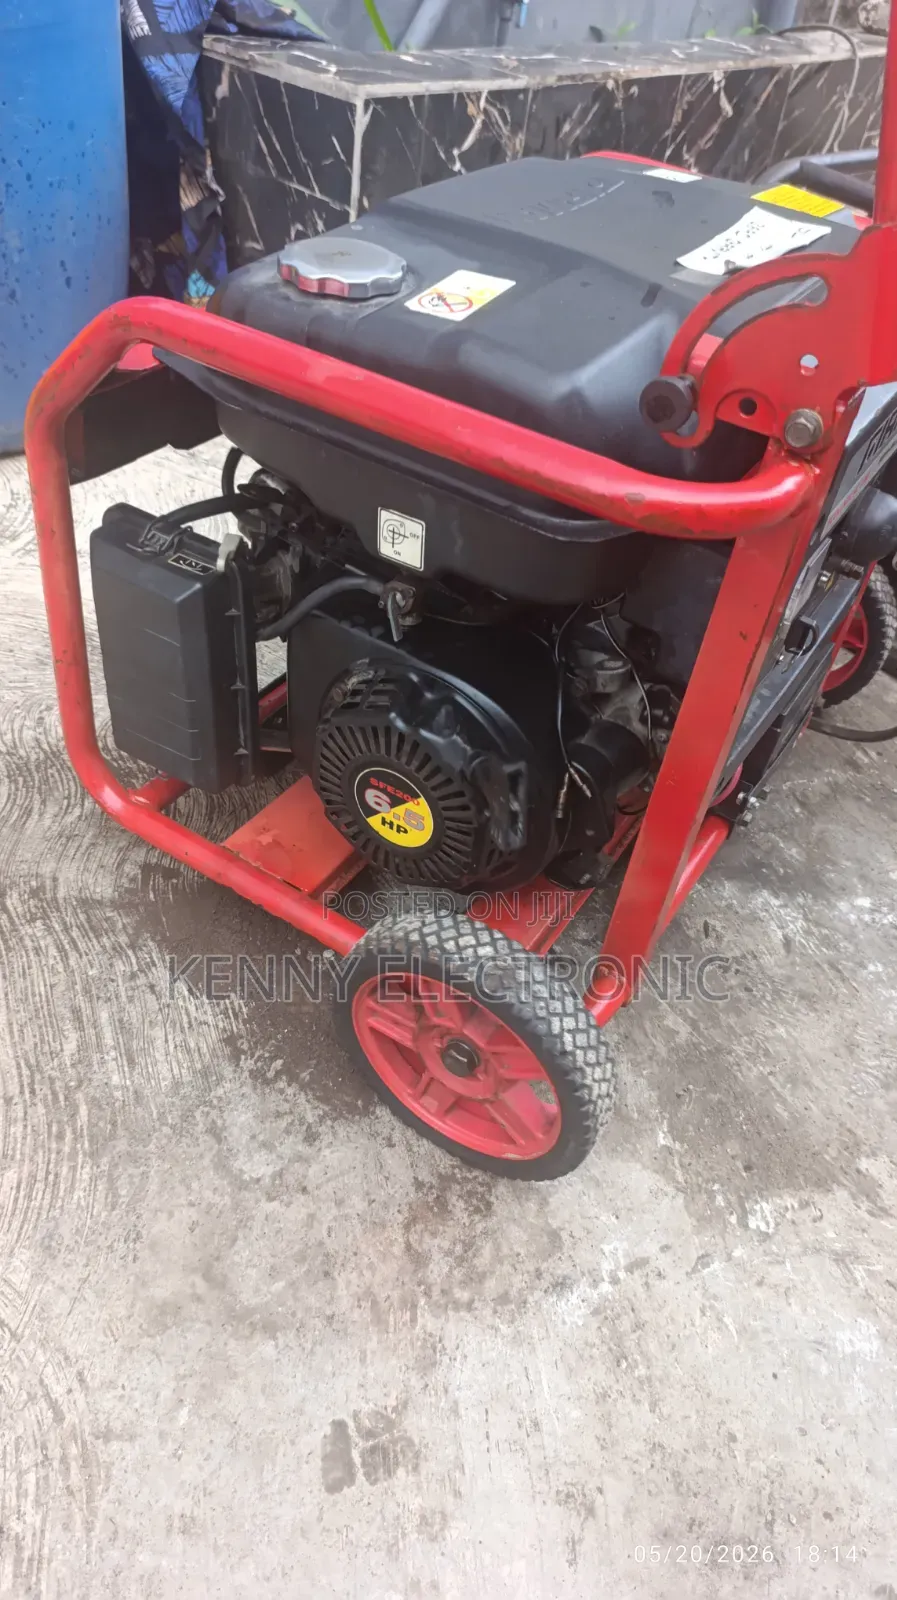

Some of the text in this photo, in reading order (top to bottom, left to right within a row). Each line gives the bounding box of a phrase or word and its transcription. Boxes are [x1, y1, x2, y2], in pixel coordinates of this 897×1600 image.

[409, 532, 420, 540] OFF
[393, 549, 402, 557] ON
[369, 777, 421, 807] SFE200
[364, 788, 426, 832] 6.5
[380, 816, 409, 835] HP
